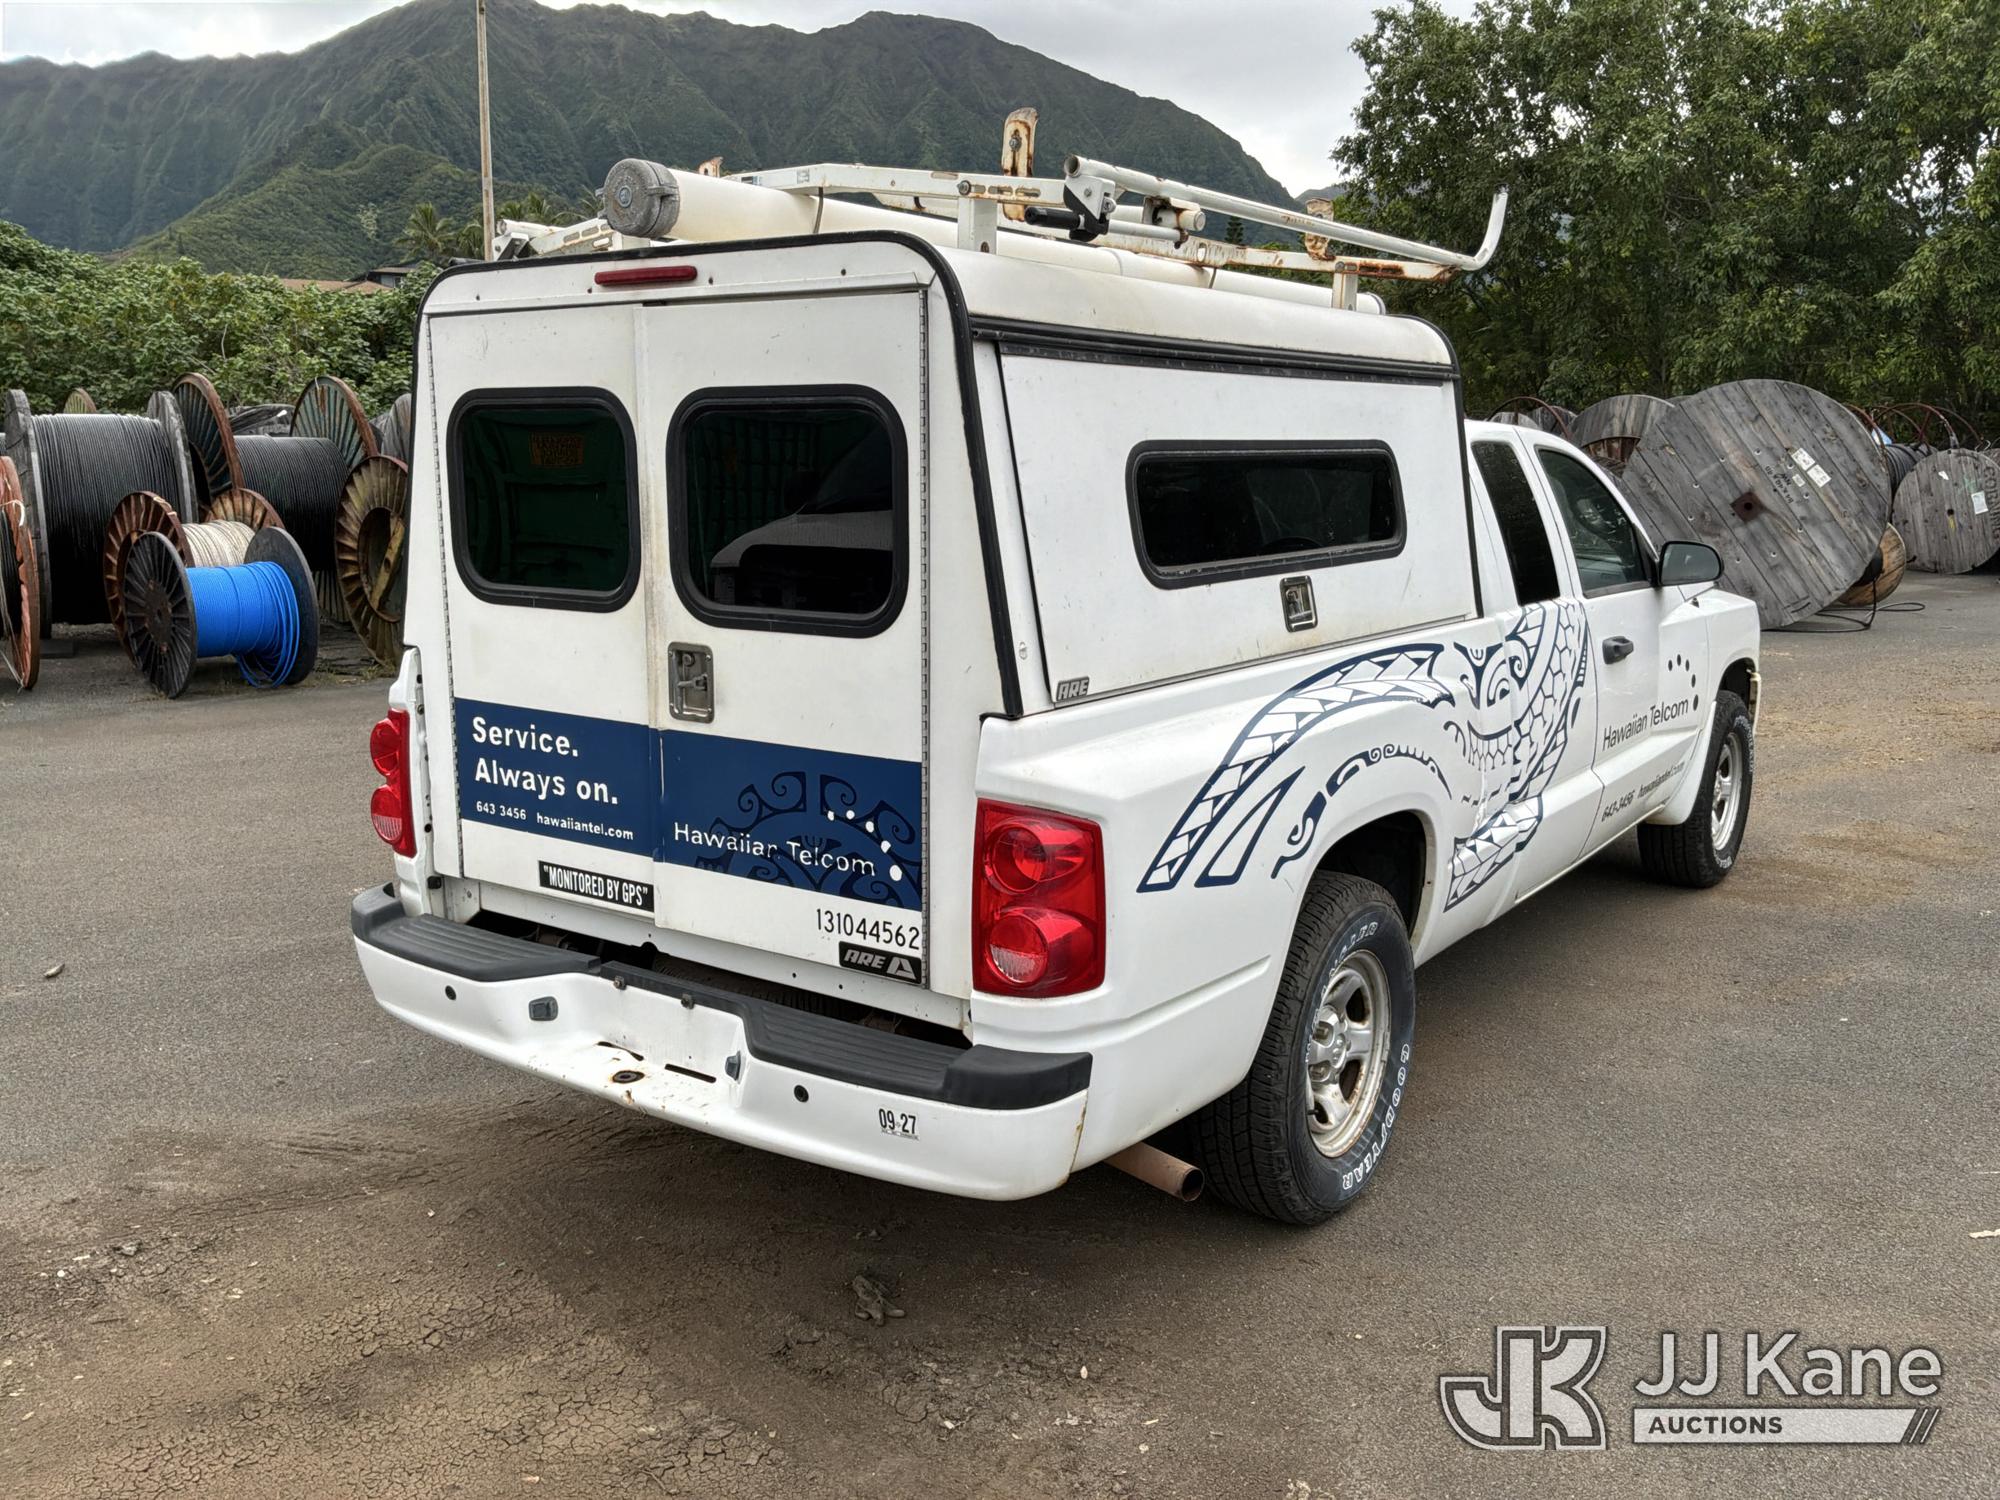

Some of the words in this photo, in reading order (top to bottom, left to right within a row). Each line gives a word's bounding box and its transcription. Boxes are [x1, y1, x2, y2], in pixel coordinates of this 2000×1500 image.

[1058, 680, 1088, 700] ARE
[472, 716, 578, 757] Service.
[1602, 713, 1648, 751] Hawaiian
[1650, 699, 1688, 728] Telcom
[475, 757, 566, 800] Always
[576, 780, 618, 804] on.
[476, 801, 495, 814] 643
[500, 805, 527, 820] 3456
[537, 812, 634, 840] hawaiiantel.com
[786, 841, 875, 876] Telcom
[607, 879, 620, 900] BY
[817, 908, 920, 950] 131044562
[844, 949, 886, 969] ARE
[1343, 1043, 1410, 1190] GOODYEAR
